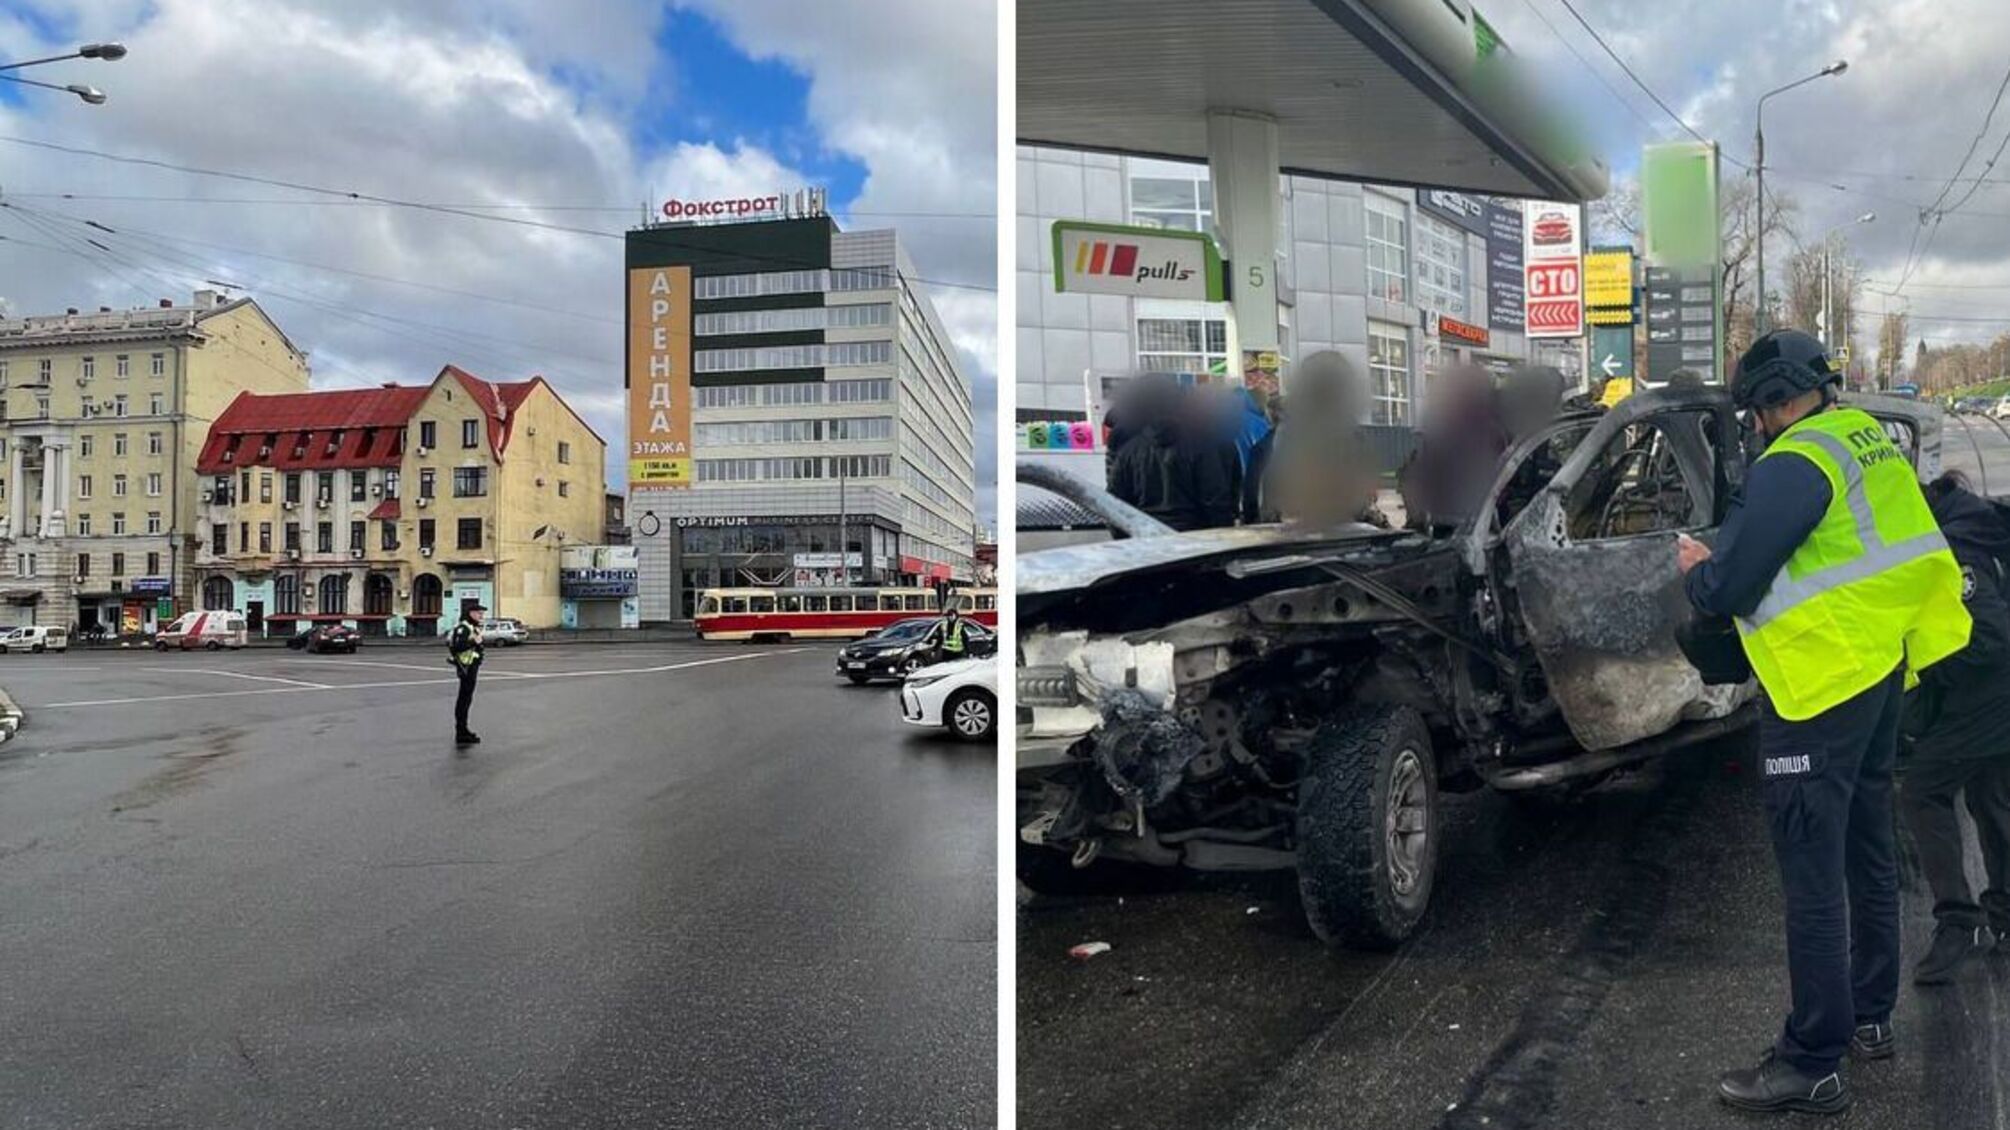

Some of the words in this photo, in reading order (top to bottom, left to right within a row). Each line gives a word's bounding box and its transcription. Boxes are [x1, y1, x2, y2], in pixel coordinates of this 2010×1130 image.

[663, 196, 779, 217] Фокстрот
[1136, 260, 1196, 283] pulls
[1248, 265, 1265, 288] 5
[1530, 268, 1577, 295] СТО
[650, 271, 672, 434] АРЕНДА
[633, 440, 686, 454] ЭТАЖА
[676, 516, 749, 528] OPTIMUM
